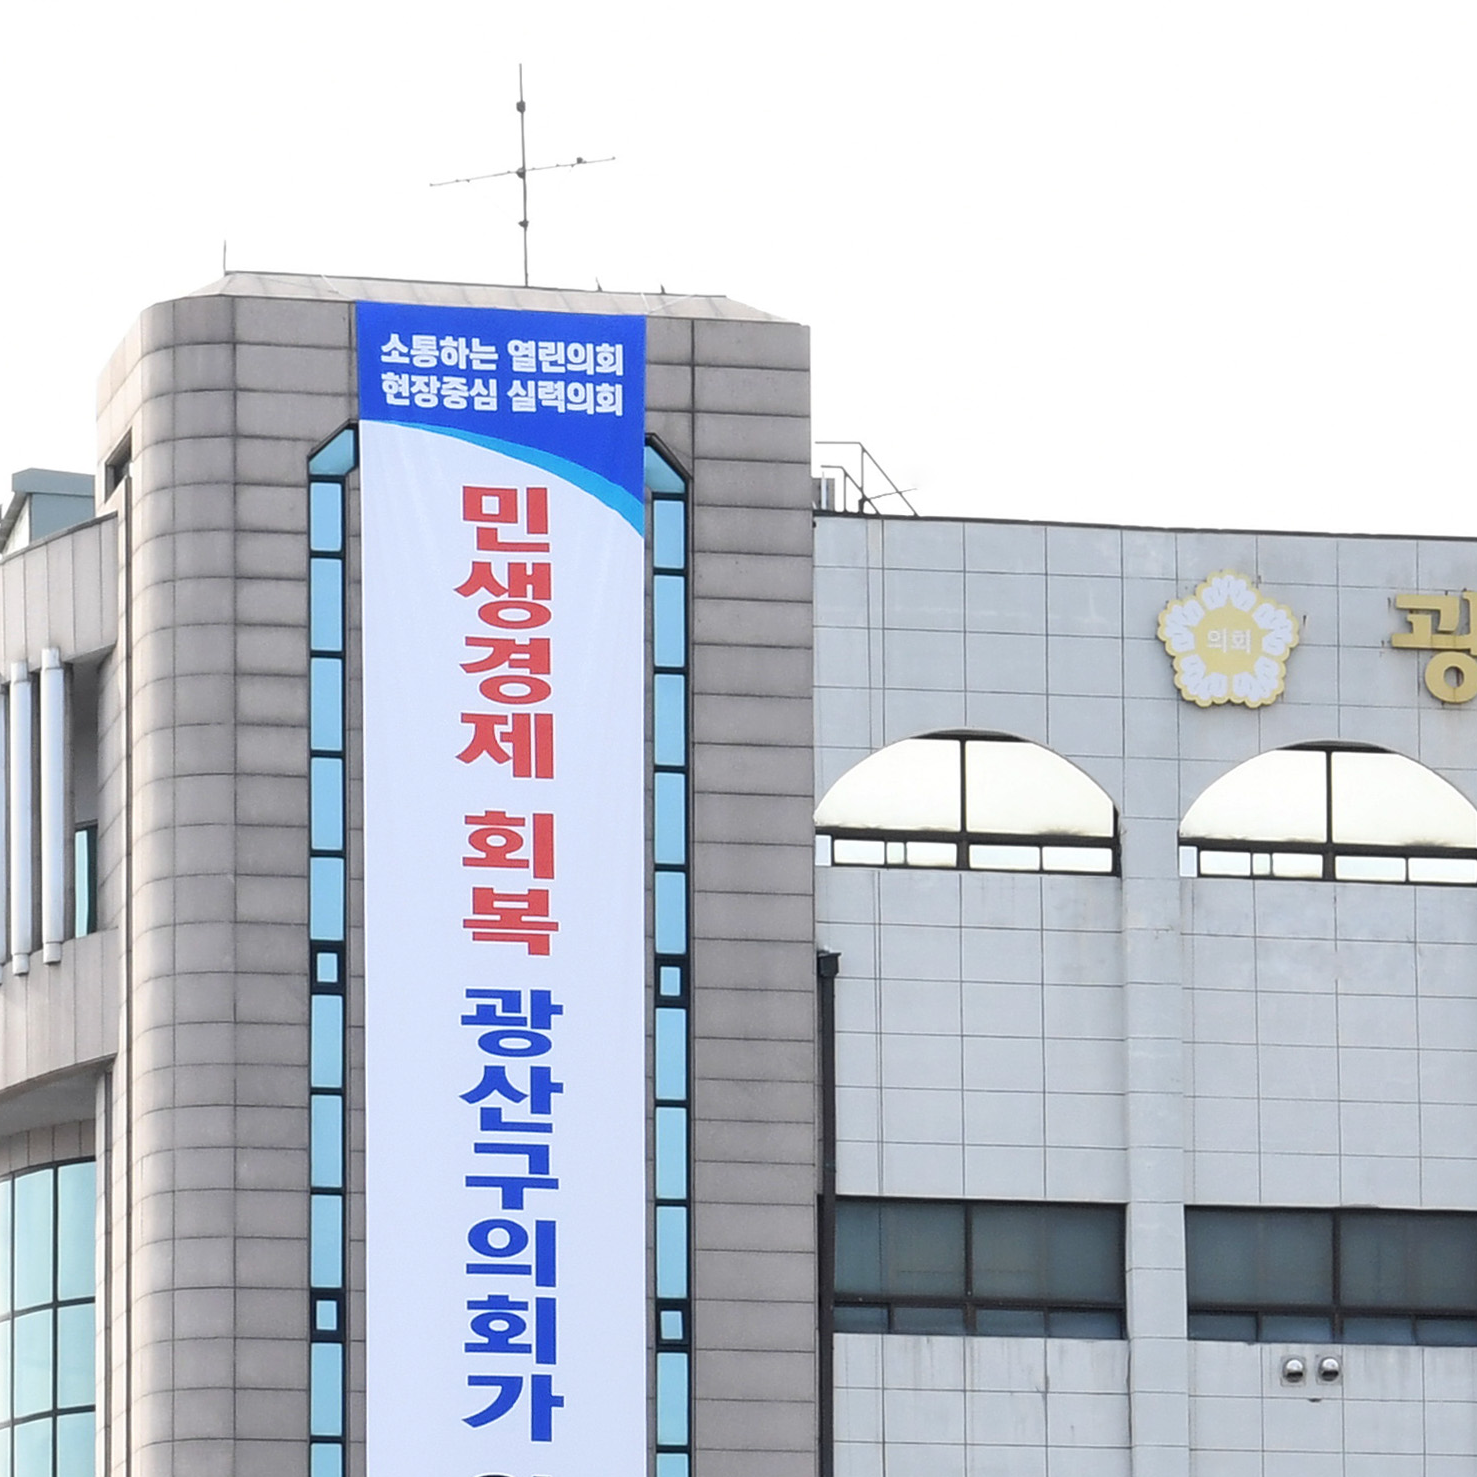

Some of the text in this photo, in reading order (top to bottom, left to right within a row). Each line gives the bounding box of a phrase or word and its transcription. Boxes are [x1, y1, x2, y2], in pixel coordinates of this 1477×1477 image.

[380, 333, 624, 376] 소통하는 열린의회
[380, 372, 624, 416] 현장중심 실력의회
[1206, 627, 1252, 655] 의회
[454, 485, 559, 957] 민생경제 회복
[458, 988, 565, 1443] 광산구의회가
